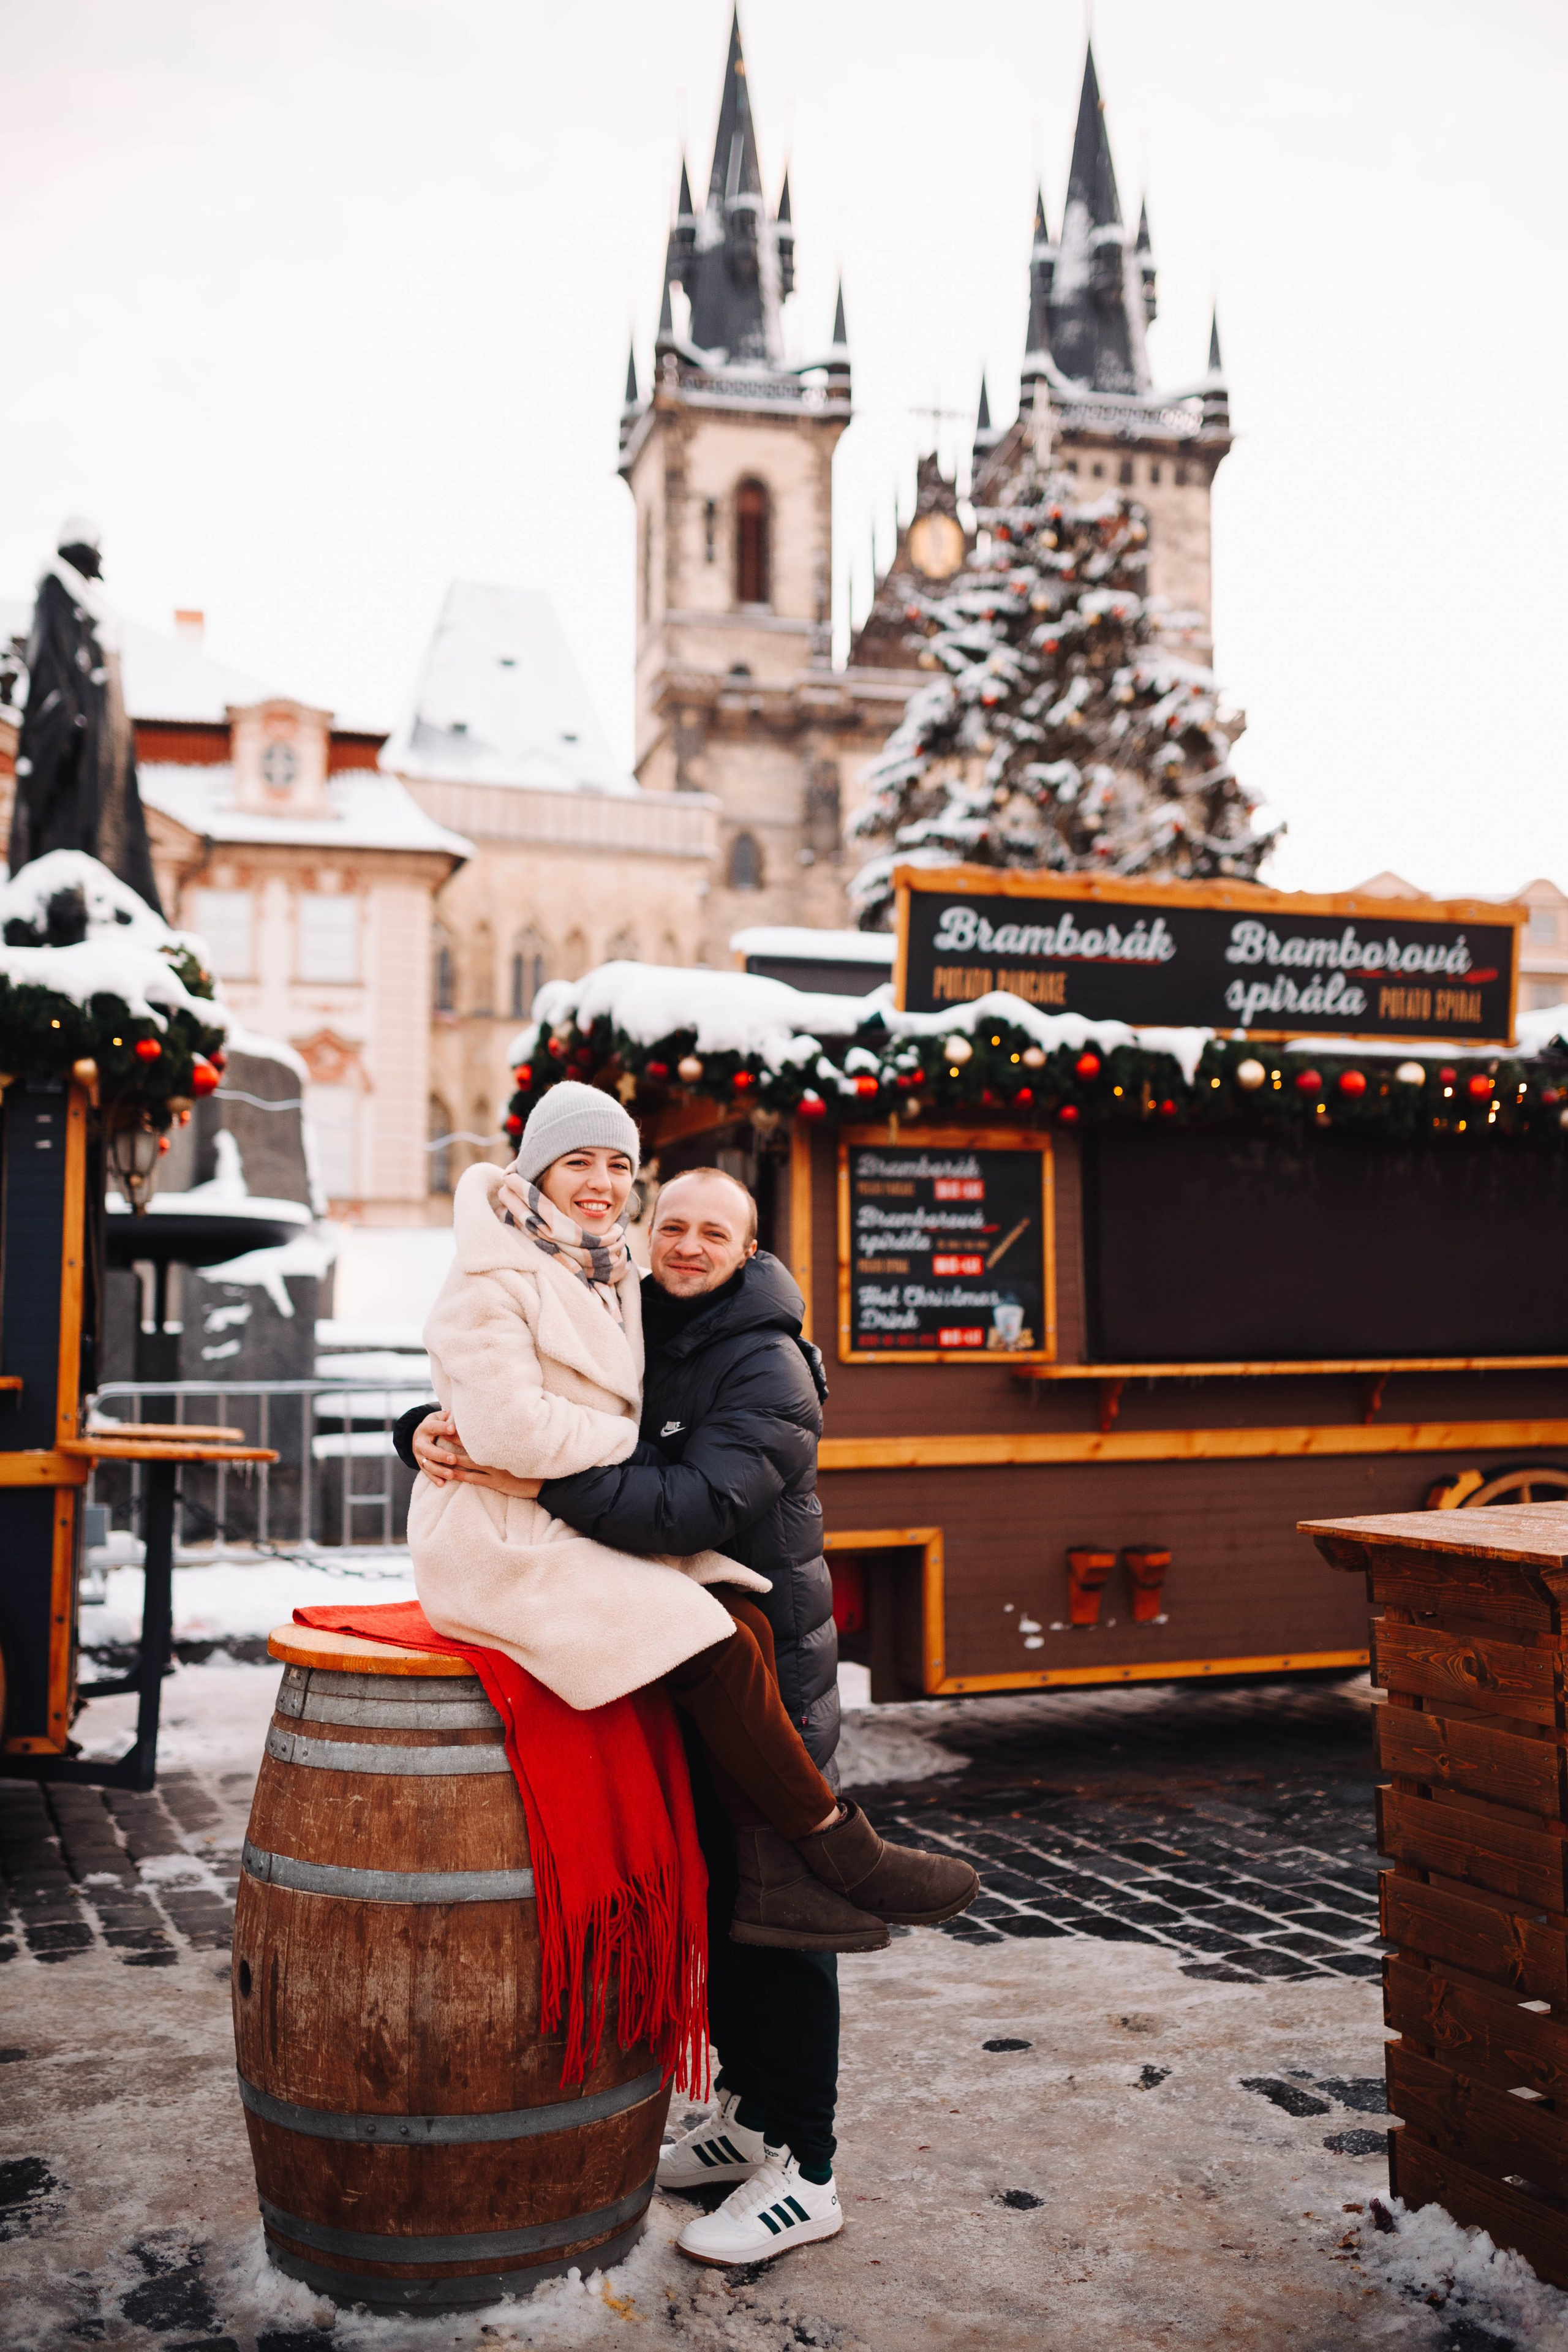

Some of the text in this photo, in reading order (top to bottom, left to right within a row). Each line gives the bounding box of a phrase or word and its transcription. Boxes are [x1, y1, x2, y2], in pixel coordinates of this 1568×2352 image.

[933, 906, 1177, 962] Bramborák
[1225, 920, 1472, 973] Bramborová
[1225, 972, 1368, 1027] spirála
[1379, 987, 1482, 1023] POTATO SPIRAL
